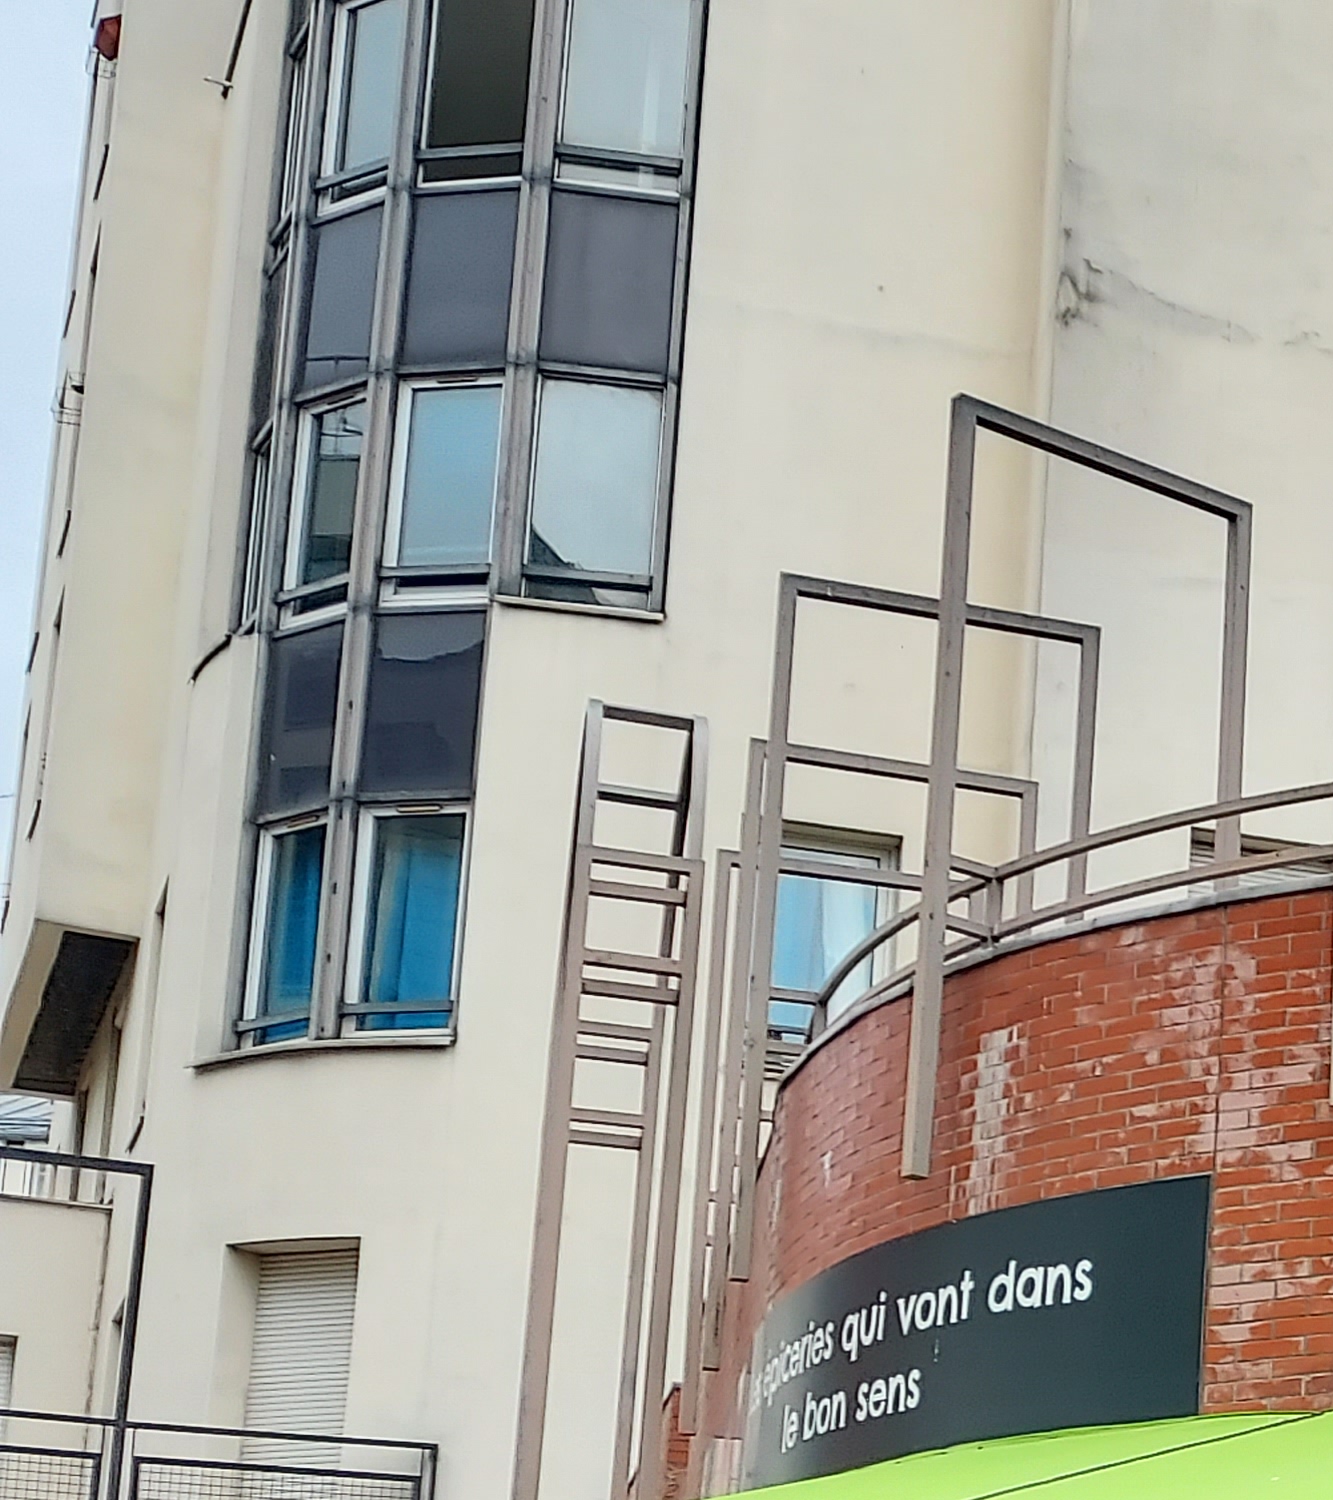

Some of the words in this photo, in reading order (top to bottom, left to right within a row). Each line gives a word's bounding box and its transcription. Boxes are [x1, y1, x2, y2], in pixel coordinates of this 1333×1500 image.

[840, 1291, 887, 1362] qui
[897, 1270, 974, 1337] vont
[987, 1258, 1093, 1315] dans
[781, 1404, 799, 1454] le
[802, 1391, 846, 1441] bon
[855, 1369, 921, 1421] sens
